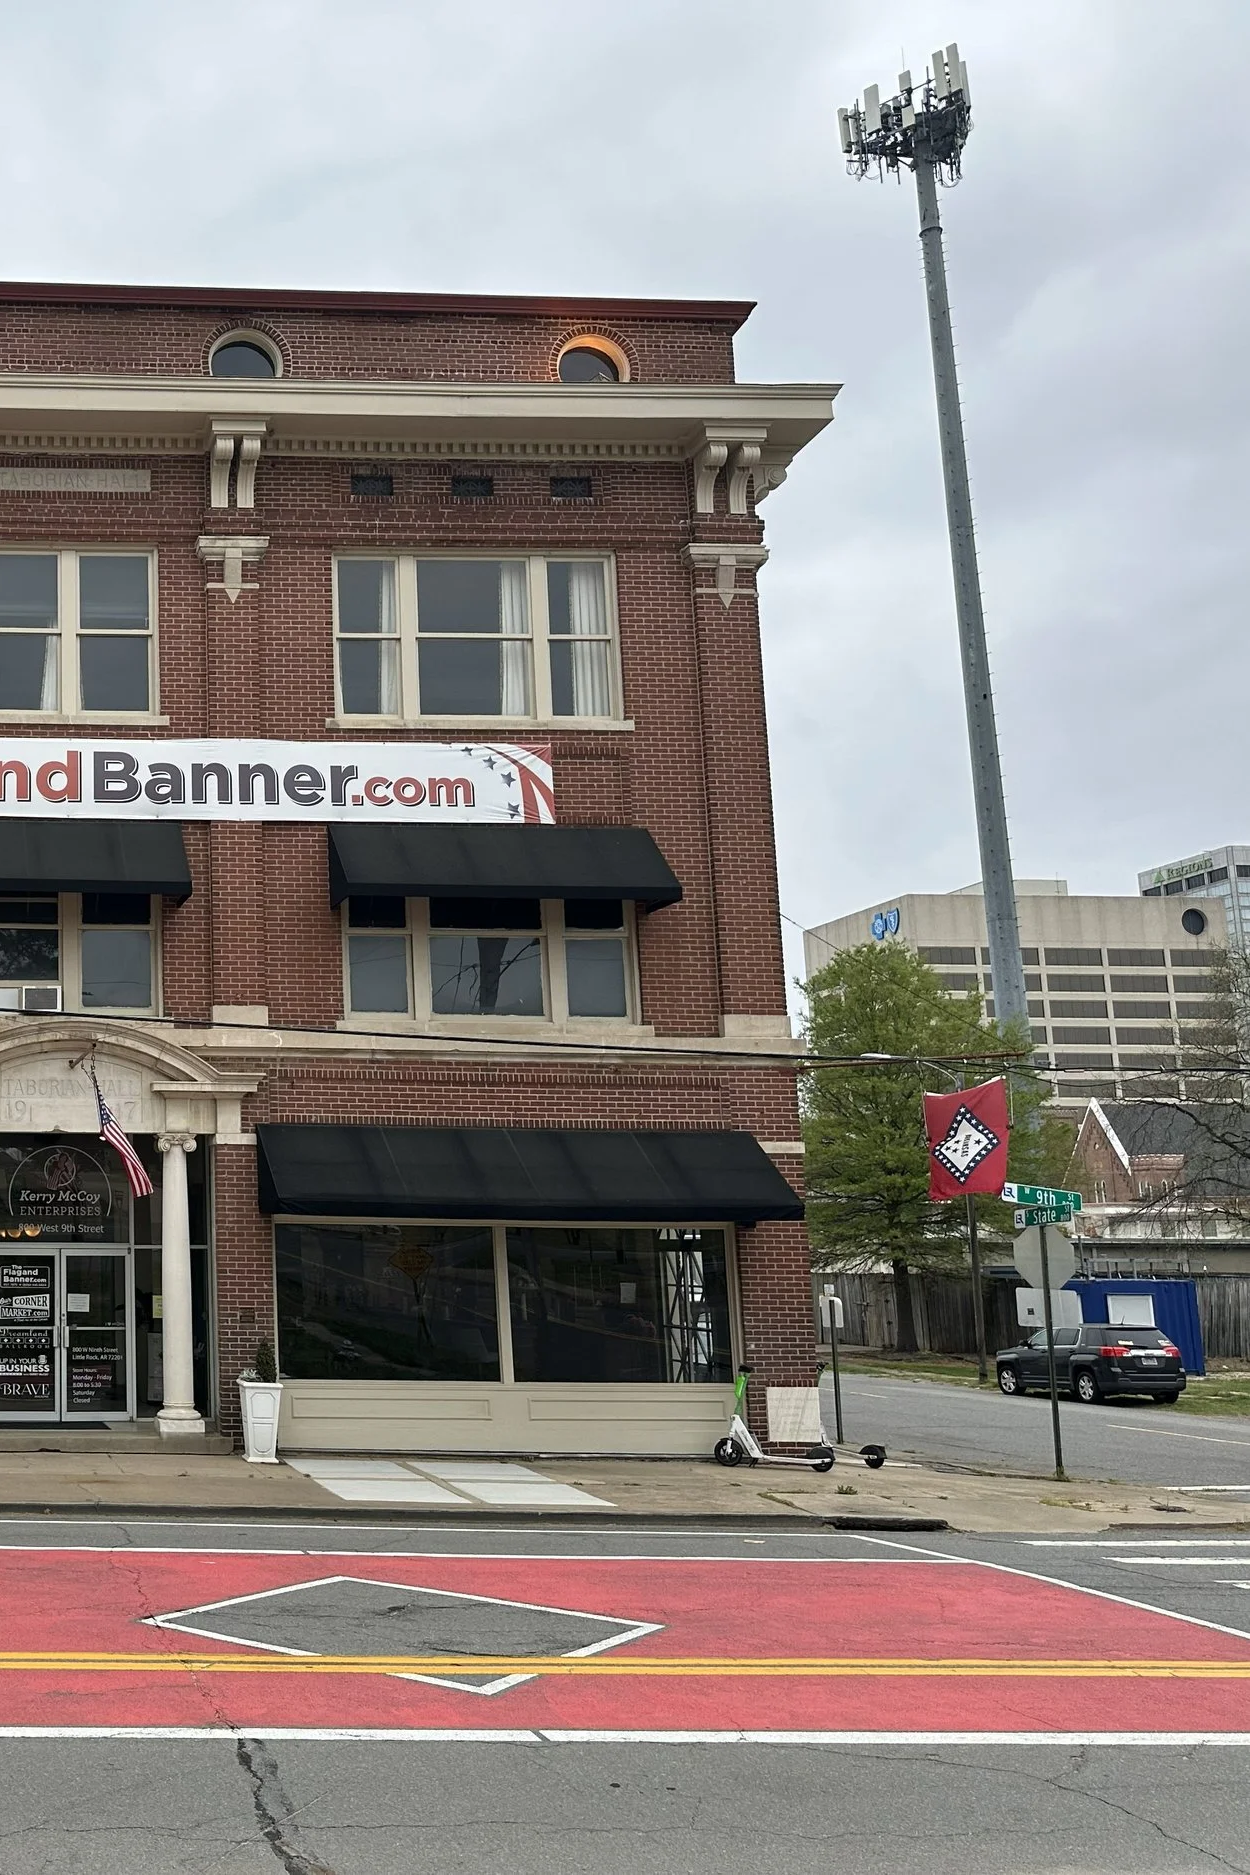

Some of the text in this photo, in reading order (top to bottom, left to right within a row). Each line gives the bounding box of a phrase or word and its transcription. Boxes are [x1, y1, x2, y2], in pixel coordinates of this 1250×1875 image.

[97, 474, 145, 489] HALL
[1166, 857, 1213, 879] REGIONS
[4, 1079, 86, 1097] TABORIAN
[6, 1099, 27, 1122] 19
[19, 1190, 101, 1204] Kerry McCoy
[1024, 1186, 1031, 1195] W
[1036, 1190, 1056, 1206] 9th
[1067, 1193, 1075, 1201] St
[19, 1206, 101, 1216] ENTERPRISES
[1032, 1208, 1057, 1225] State
[1064, 1205, 1071, 1213] St
[18, 1222, 105, 1233] 800 West 9th Street
[3, 1268, 39, 1276] Flagand
[3, 1275, 47, 1283] Banner.com
[14, 1295, 48, 1307] CORNER
[1, 1307, 48, 1317] MARKET.com
[72, 1374, 93, 1382] Monday
